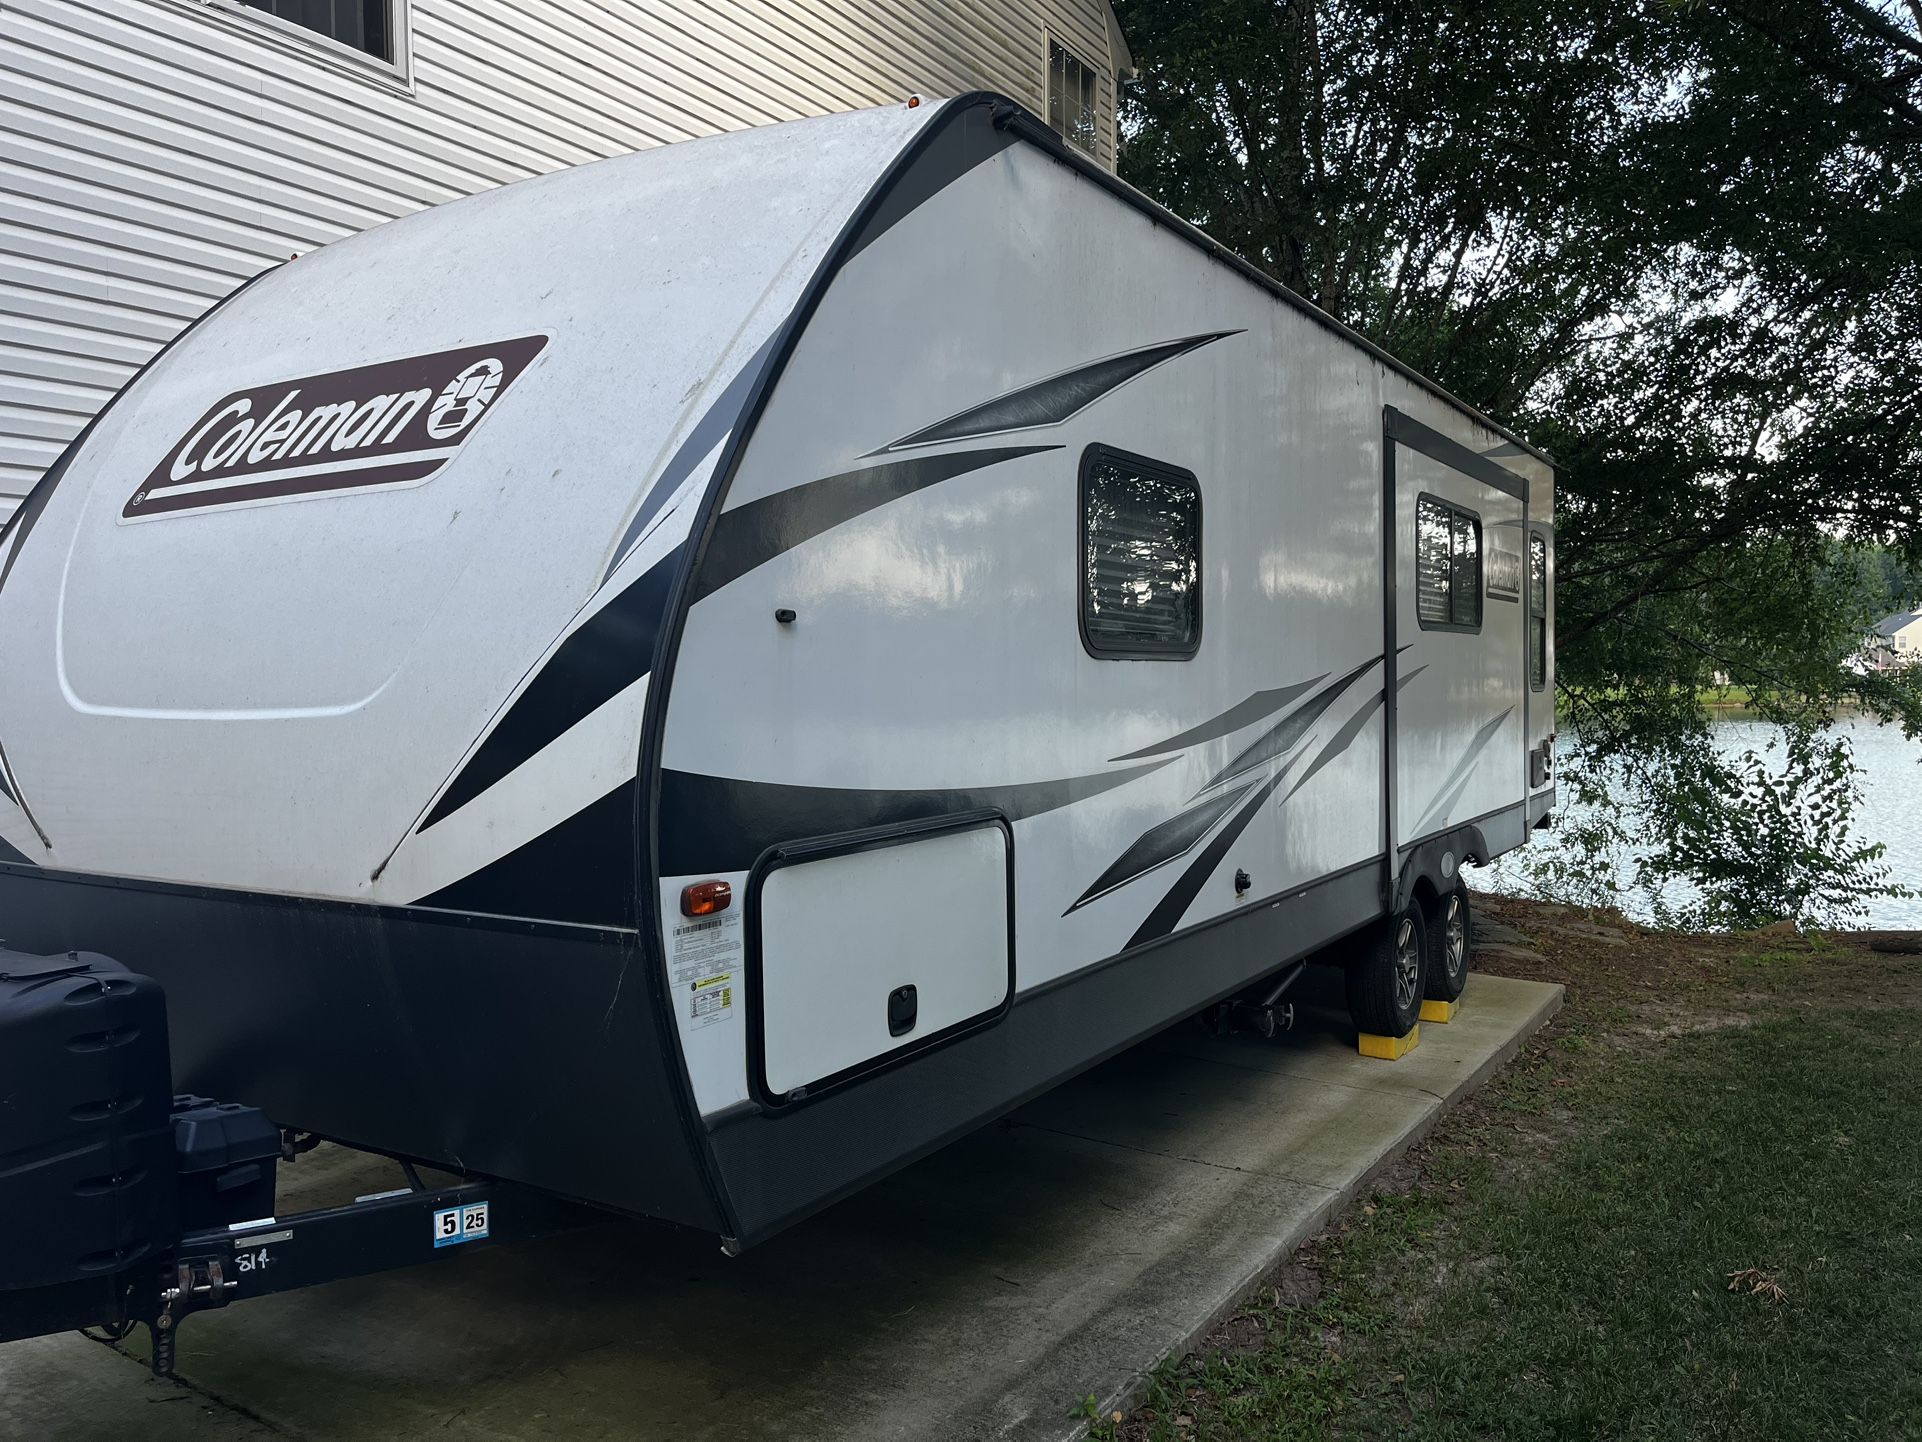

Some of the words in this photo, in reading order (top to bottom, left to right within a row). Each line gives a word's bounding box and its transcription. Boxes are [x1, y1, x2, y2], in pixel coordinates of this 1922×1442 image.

[170, 388, 432, 481] Coleman
[443, 1213, 456, 1235] 5
[465, 1212, 485, 1230] 25
